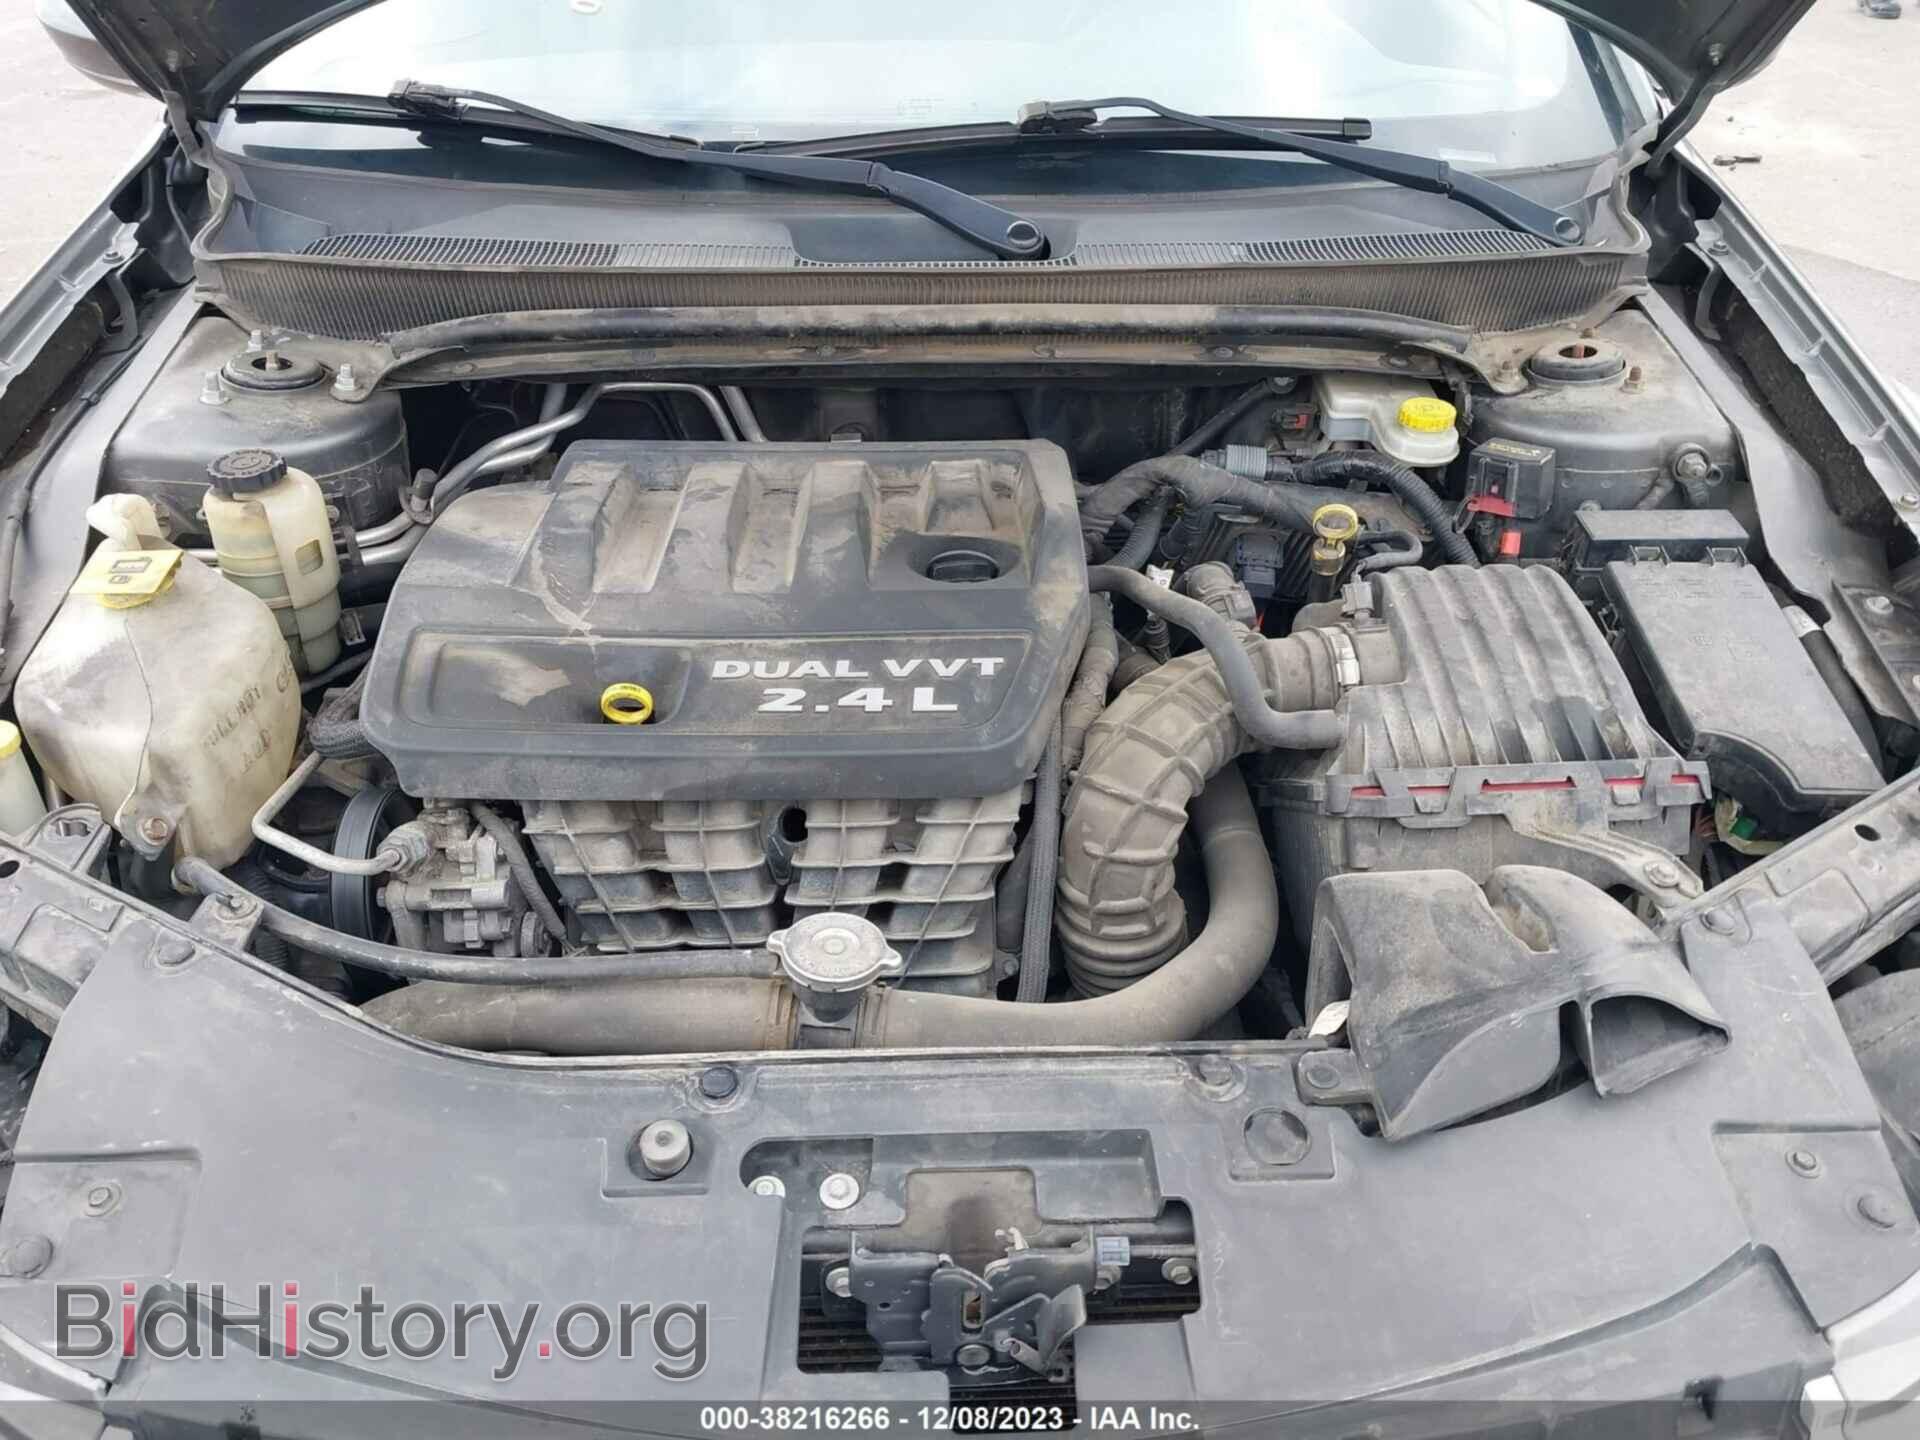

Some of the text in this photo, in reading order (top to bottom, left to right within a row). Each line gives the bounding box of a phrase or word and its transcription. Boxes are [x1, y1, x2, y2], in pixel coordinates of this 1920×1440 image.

[712, 657, 1004, 678] DUAL VVT
[758, 687, 958, 713] 2.4 L
